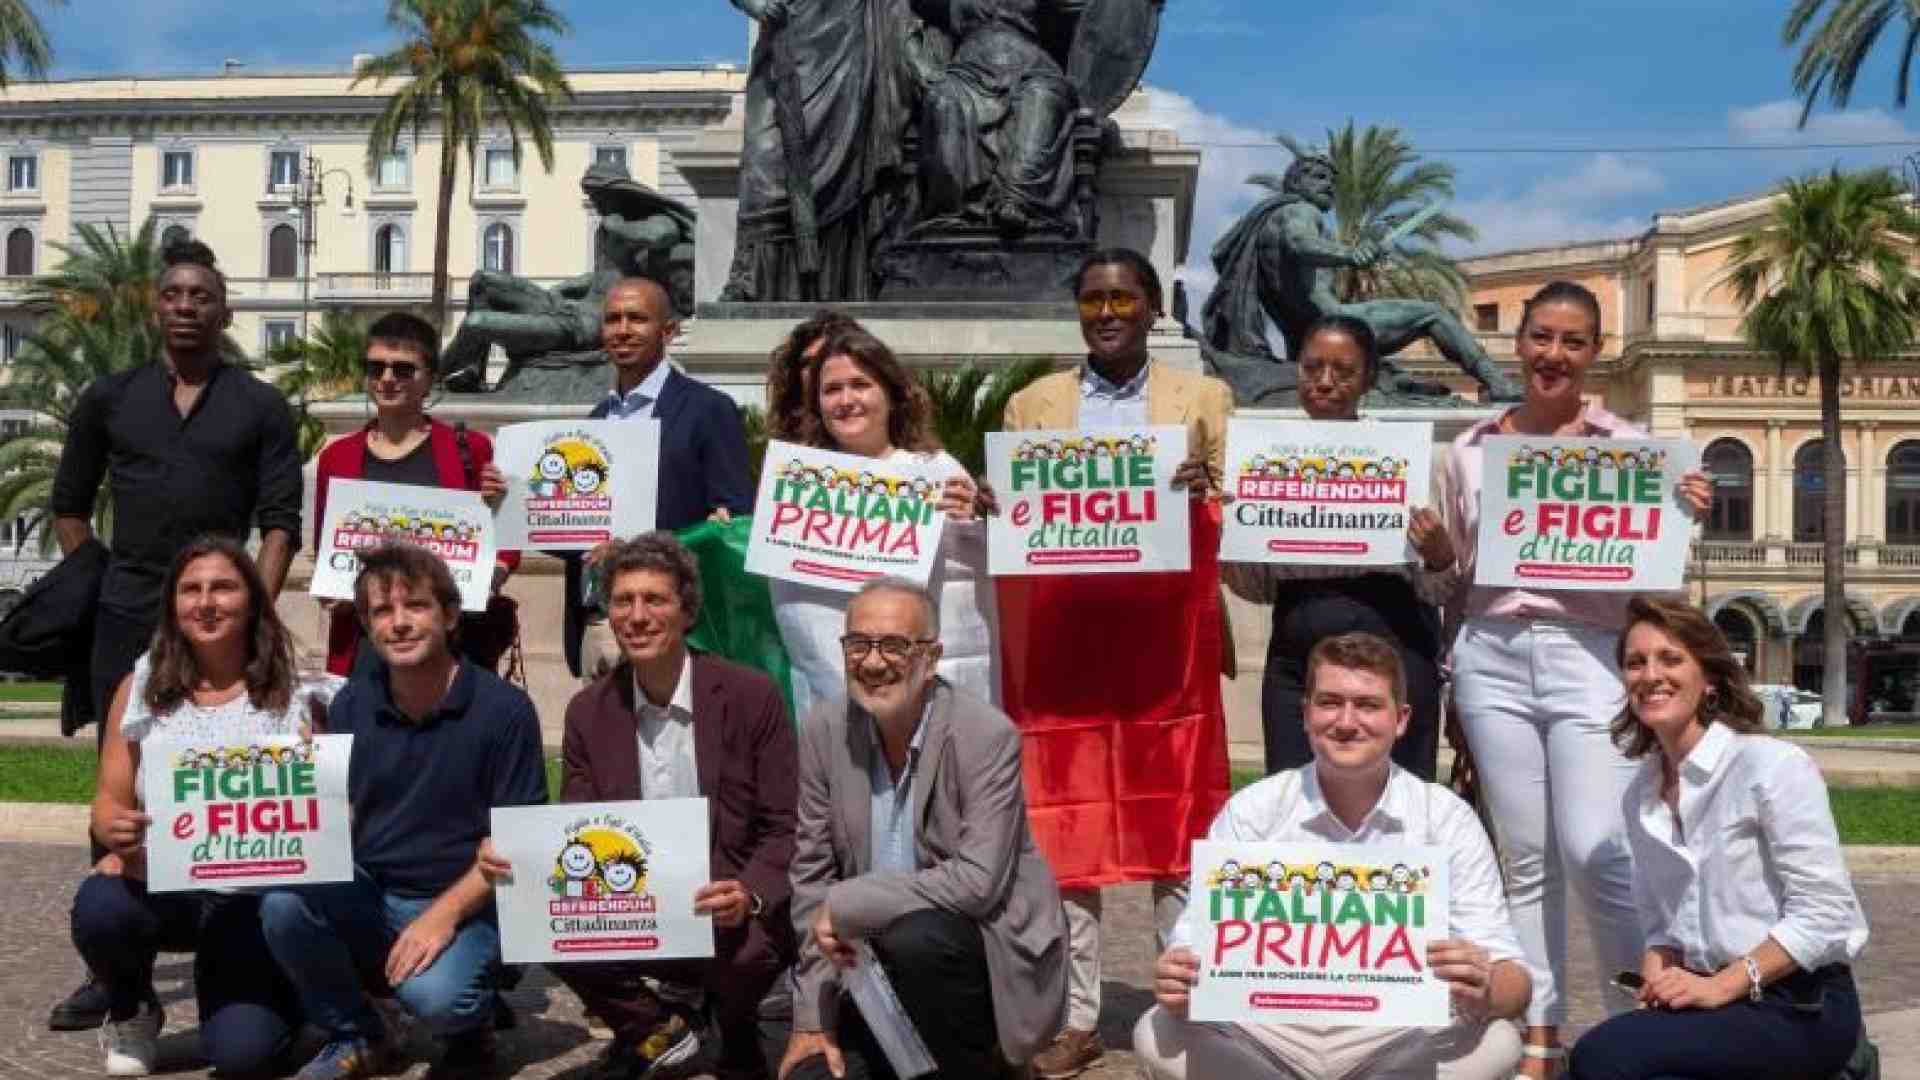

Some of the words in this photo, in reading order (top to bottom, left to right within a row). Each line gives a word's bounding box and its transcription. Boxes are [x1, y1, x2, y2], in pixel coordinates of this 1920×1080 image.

[1010, 456, 1155, 490] FIGLIE
[1242, 480, 1400, 500] REFERENDUM
[1507, 463, 1664, 503] FIGLIE
[773, 478, 935, 525] ITALIANI
[1012, 500, 1030, 525] e
[1043, 491, 1158, 524] FIGLI
[1236, 504, 1403, 528] Cittadinanza
[770, 503, 920, 555] PRIMA
[1028, 522, 1138, 547] d'Italia
[1504, 509, 1524, 535] e
[1537, 503, 1661, 541] FIGLI
[1519, 534, 1635, 562] d'Italia
[174, 763, 317, 802] FIGLIE
[174, 813, 194, 839] e
[207, 799, 320, 834] FIGLI
[192, 833, 303, 862] d'Italia
[551, 916, 658, 933] Cittadinanza
[1210, 889, 1424, 926] ITALIANI
[1215, 921, 1422, 972] PRIMA
